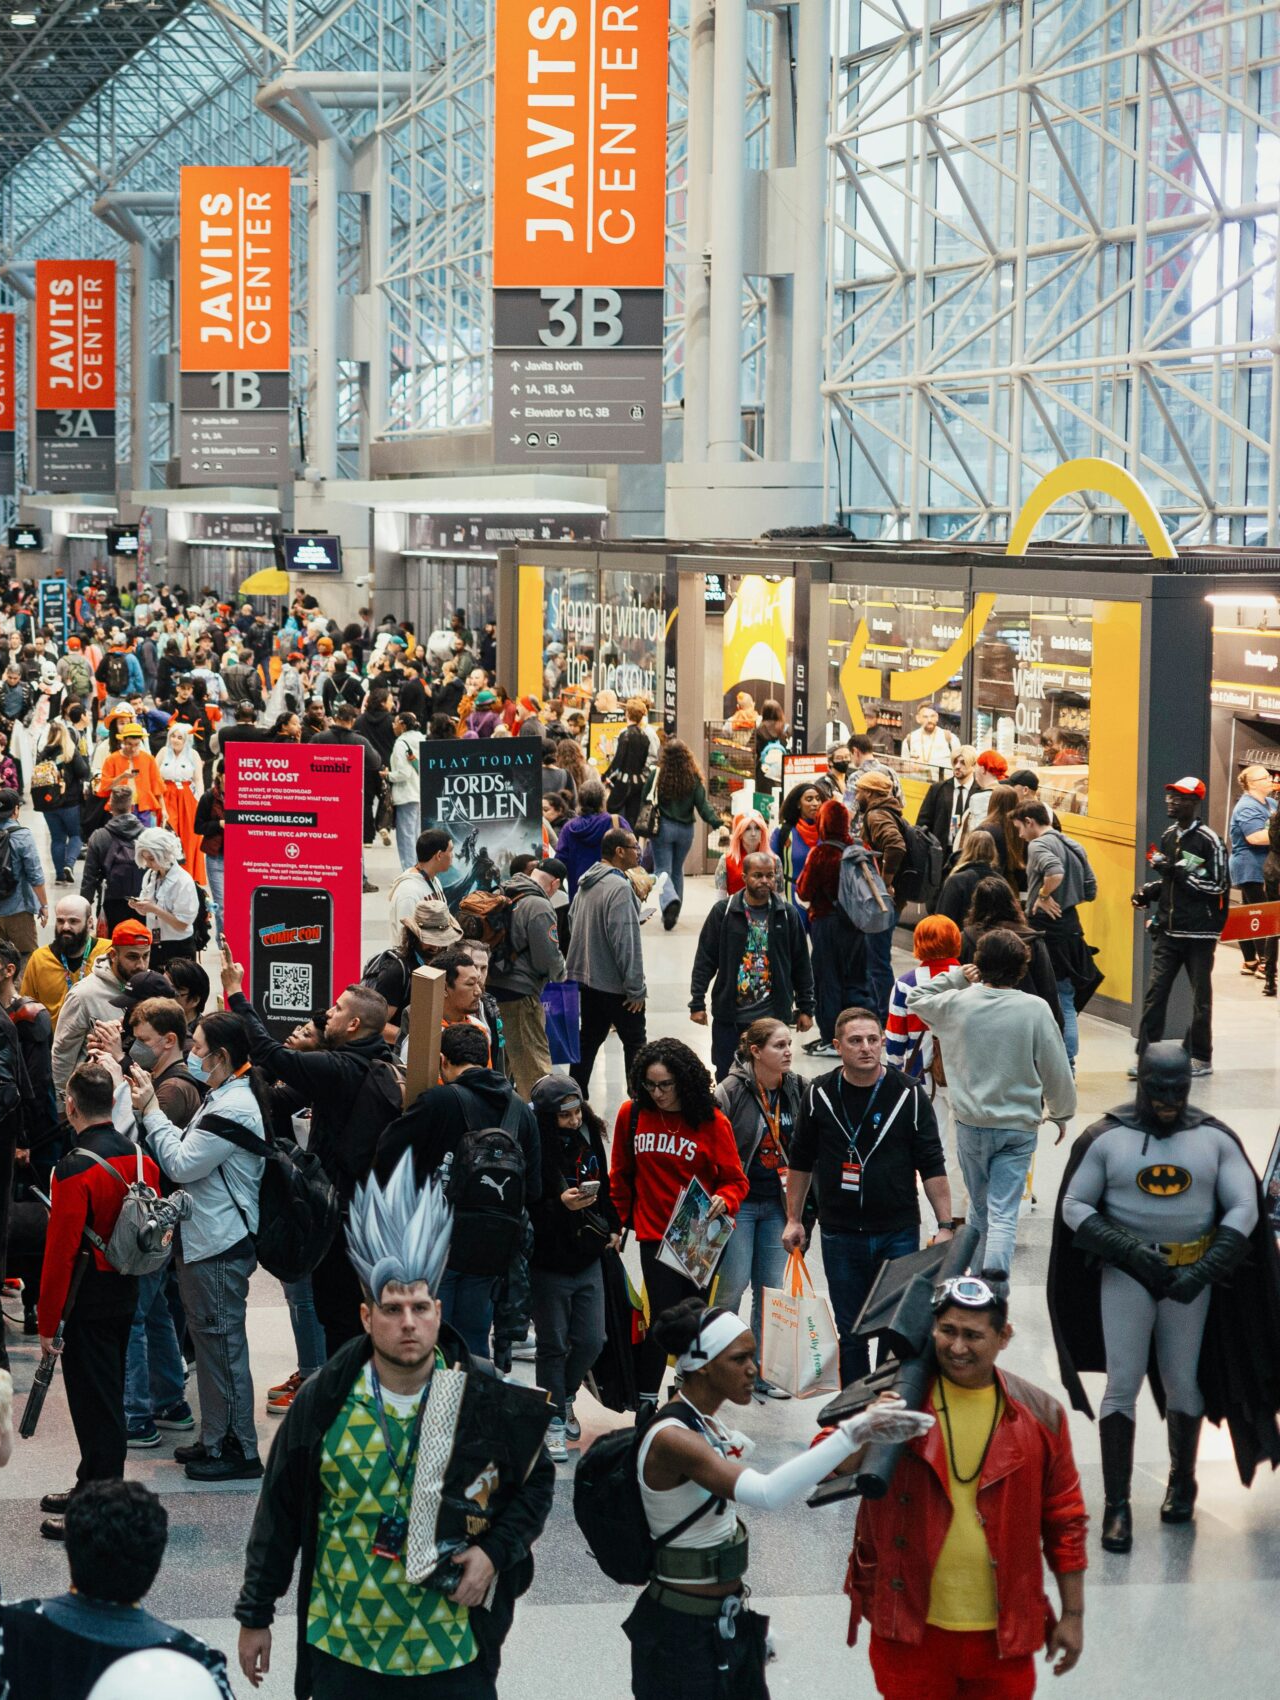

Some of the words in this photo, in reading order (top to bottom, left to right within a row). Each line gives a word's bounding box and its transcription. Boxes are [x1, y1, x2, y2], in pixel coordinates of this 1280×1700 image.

[526, 5, 577, 242] JAVITS
[598, 5, 639, 244] CENTER
[200, 193, 233, 343] JAVITS
[246, 192, 271, 344] CENTER
[538, 288, 623, 347] 3B
[50, 279, 74, 388] JAVITS
[84, 278, 103, 389] CENTER
[525, 361, 553, 371] Javits
[555, 361, 584, 371] North
[211, 372, 261, 409] 1B
[525, 384, 541, 395] 1A,
[543, 384, 559, 395] 1B,
[561, 384, 575, 394] 3A
[55, 410, 98, 438] 3A
[525, 408, 563, 418] Elevator
[565, 408, 576, 418] to
[551, 588, 612, 648] Shopping
[616, 594, 666, 642] withou
[1015, 631, 1043, 662] Just
[566, 646, 588, 687] the
[1013, 667, 1046, 699] Walk
[1015, 703, 1041, 734] Out
[238, 758, 263, 769] HEY,
[265, 759, 289, 769] YOU
[238, 771, 269, 781] LOOK
[271, 773, 299, 783] LOST
[310, 763, 352, 773] tumblr
[429, 757, 469, 769] PLAY
[480, 754, 533, 766] TODAY
[444, 774, 504, 795] LORDS
[238, 814, 313, 824] NYCCMOBILE.COM
[436, 792, 527, 822] FALLEN
[263, 929, 297, 945] COMIC
[298, 926, 320, 942] CON
[634, 1133, 655, 1156] FOR
[657, 1133, 698, 1162] DAYS
[807, 1315, 820, 1350] wholly
